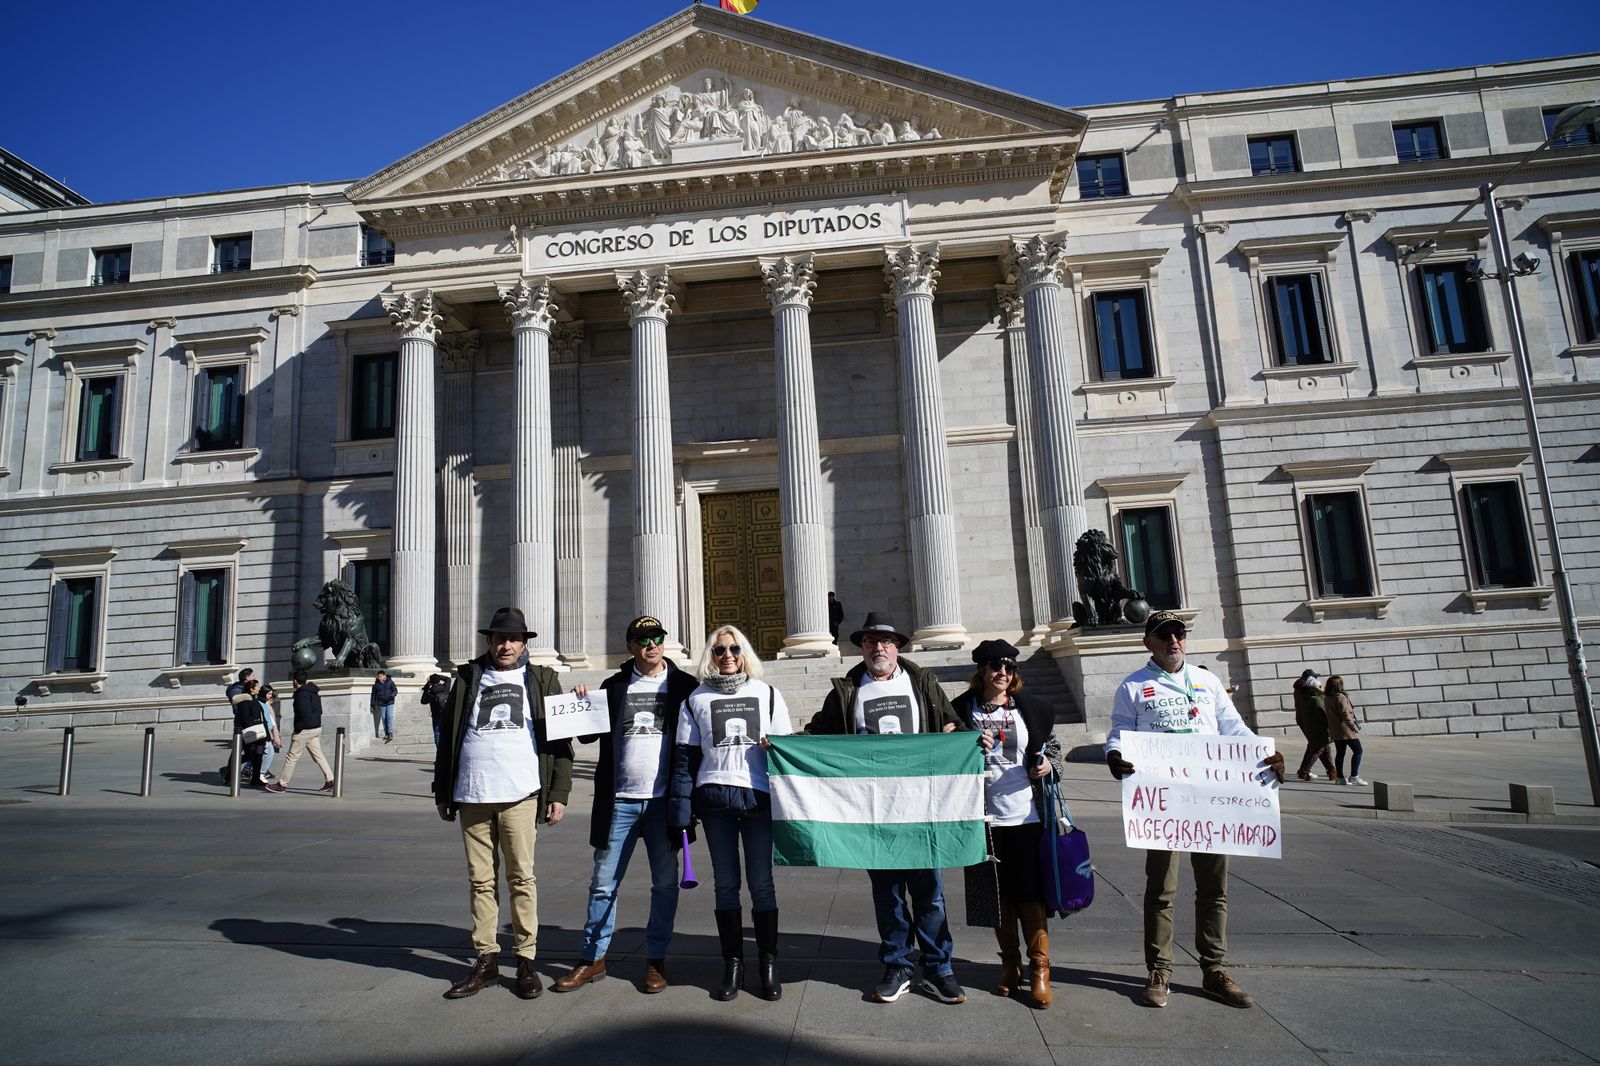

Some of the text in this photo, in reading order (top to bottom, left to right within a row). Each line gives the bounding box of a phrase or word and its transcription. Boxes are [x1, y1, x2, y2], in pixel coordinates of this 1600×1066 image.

[545, 212, 882, 258] CONGRESO DE LOS DIPUTADOS
[552, 701, 592, 716] 12.352
[1159, 710, 1170, 718] ES
[1173, 708, 1185, 716] DE
[1169, 766, 1189, 778] NO
[1132, 784, 1270, 813] AVE DEL ESTRECHO
[1128, 818, 1277, 847] ALGECIRAS-MADRID
[1167, 840, 1212, 852] CEUTA
